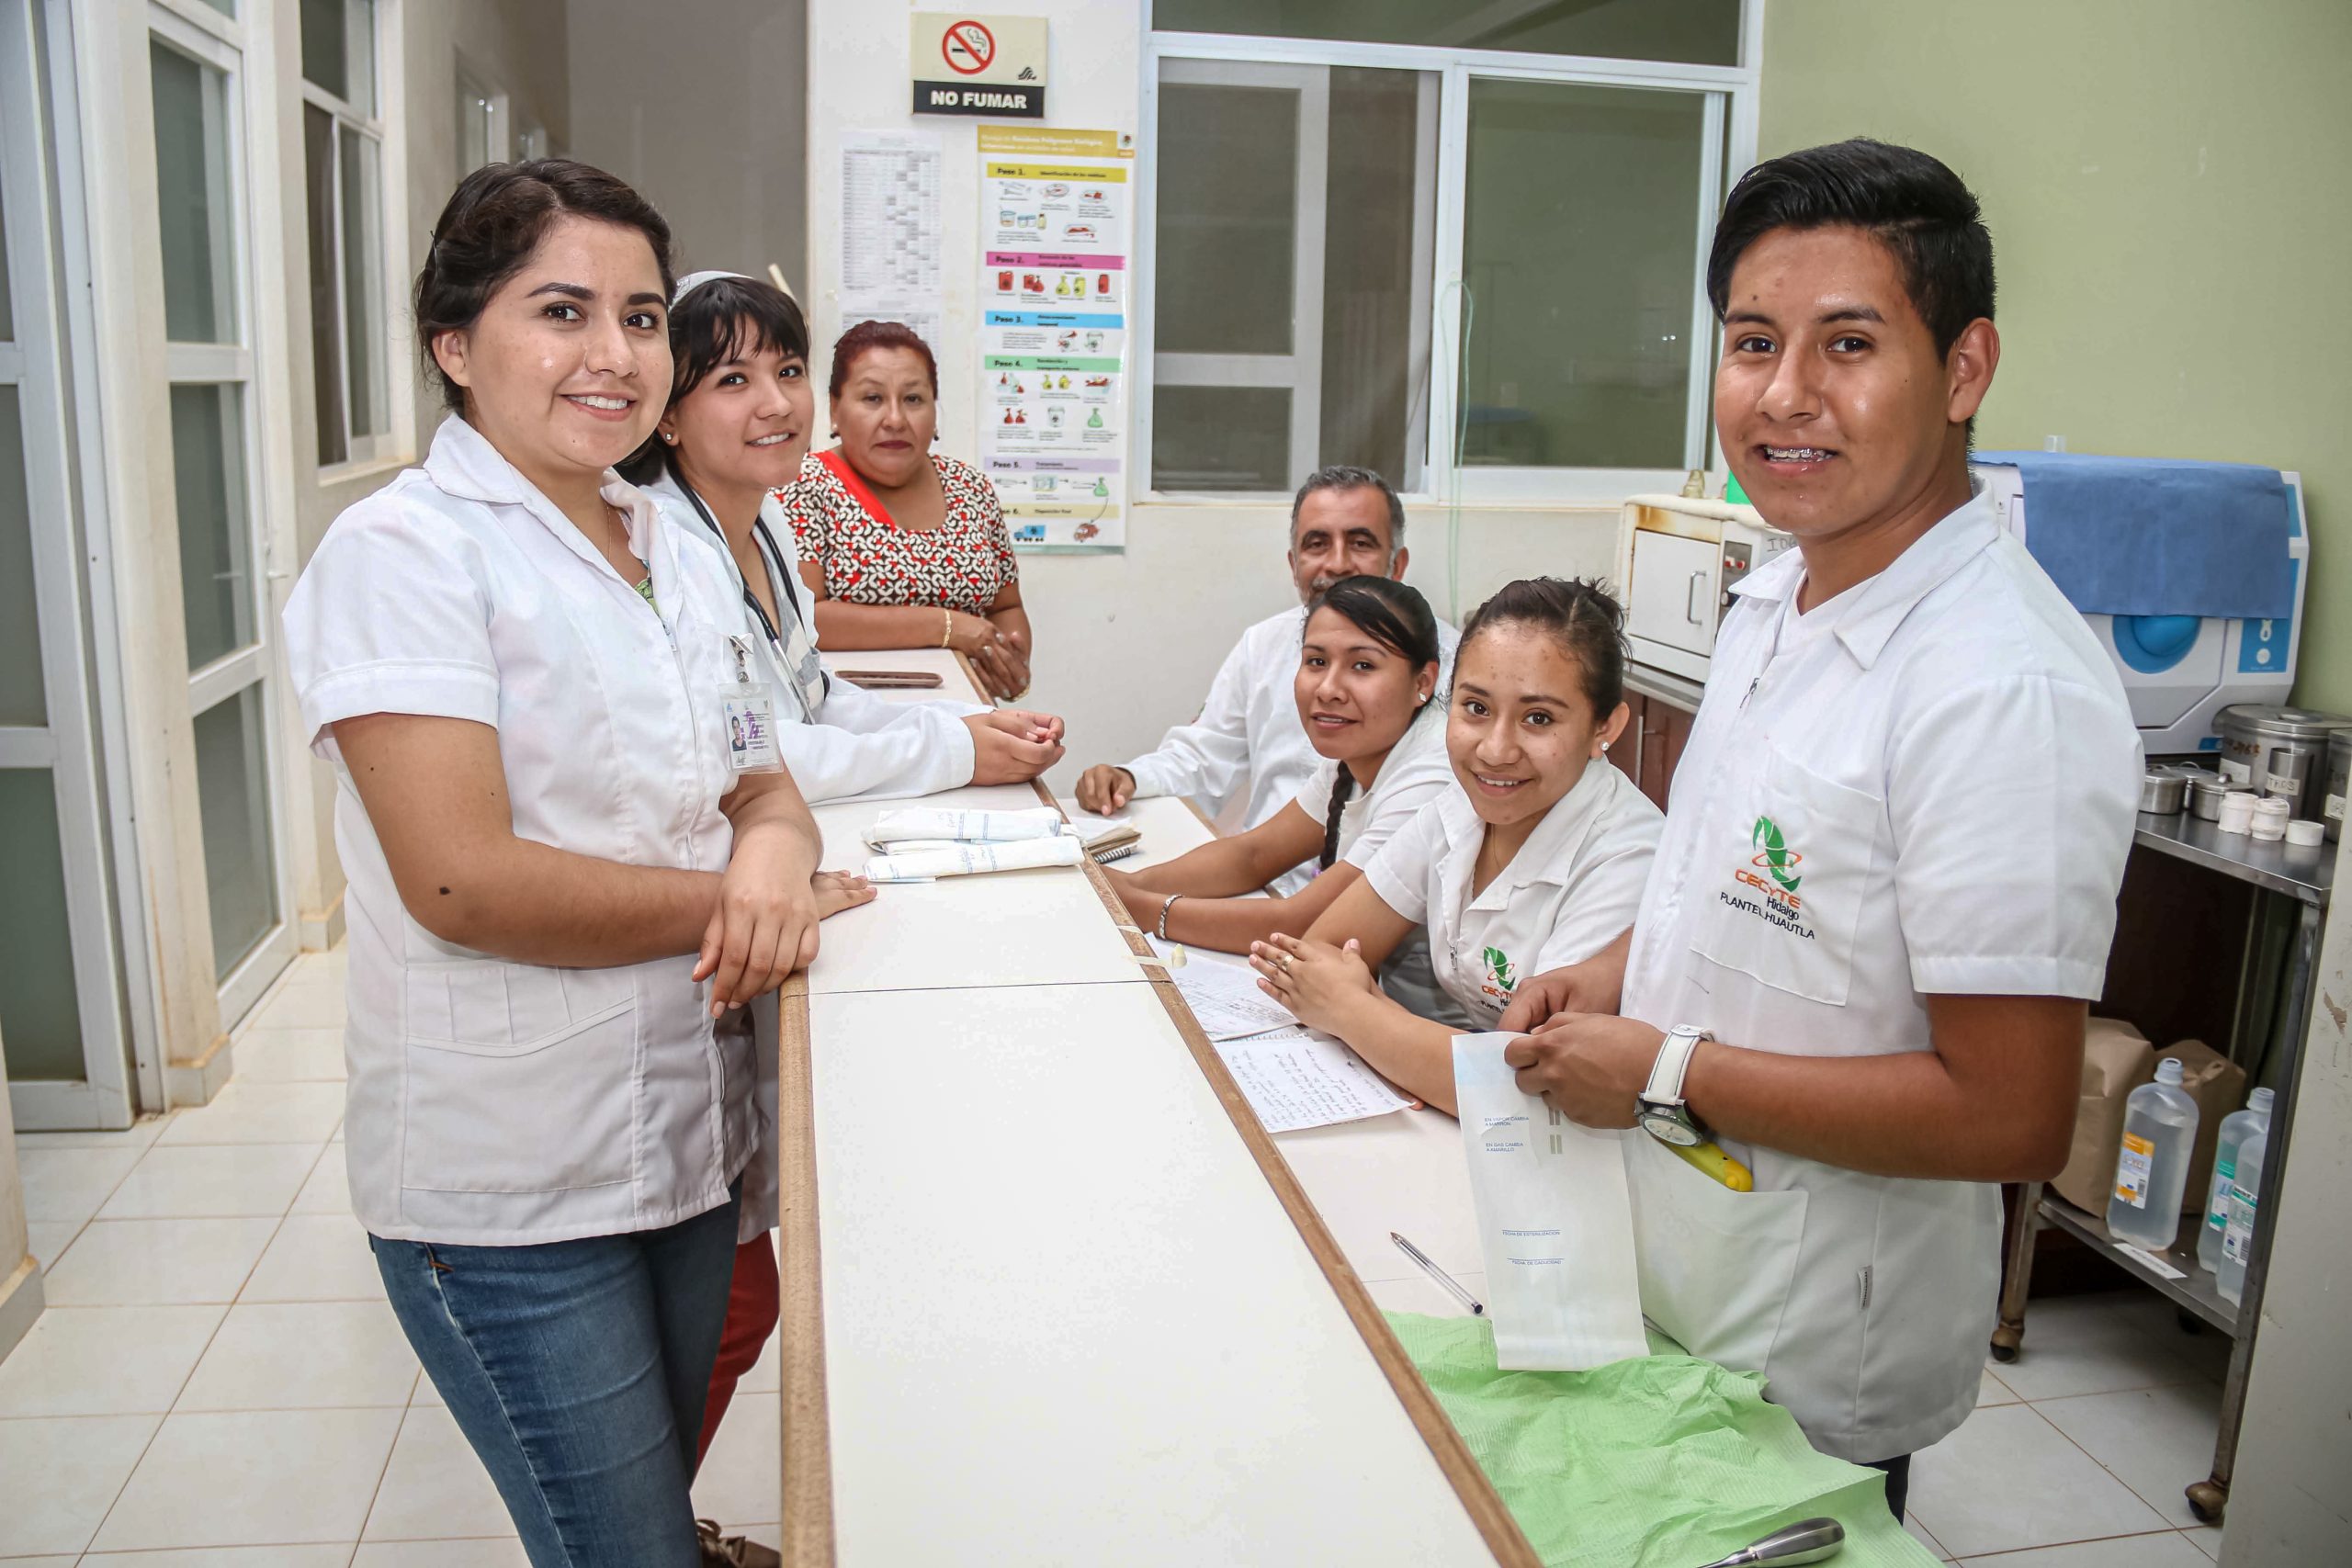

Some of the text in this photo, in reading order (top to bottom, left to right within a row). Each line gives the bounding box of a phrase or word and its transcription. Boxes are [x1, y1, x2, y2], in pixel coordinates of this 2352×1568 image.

[931, 90, 1027, 109] NO FUMAR
[1720, 892, 1815, 940] PLANTEL HUAUTLA
[1767, 897, 1800, 920] Hidalgo
